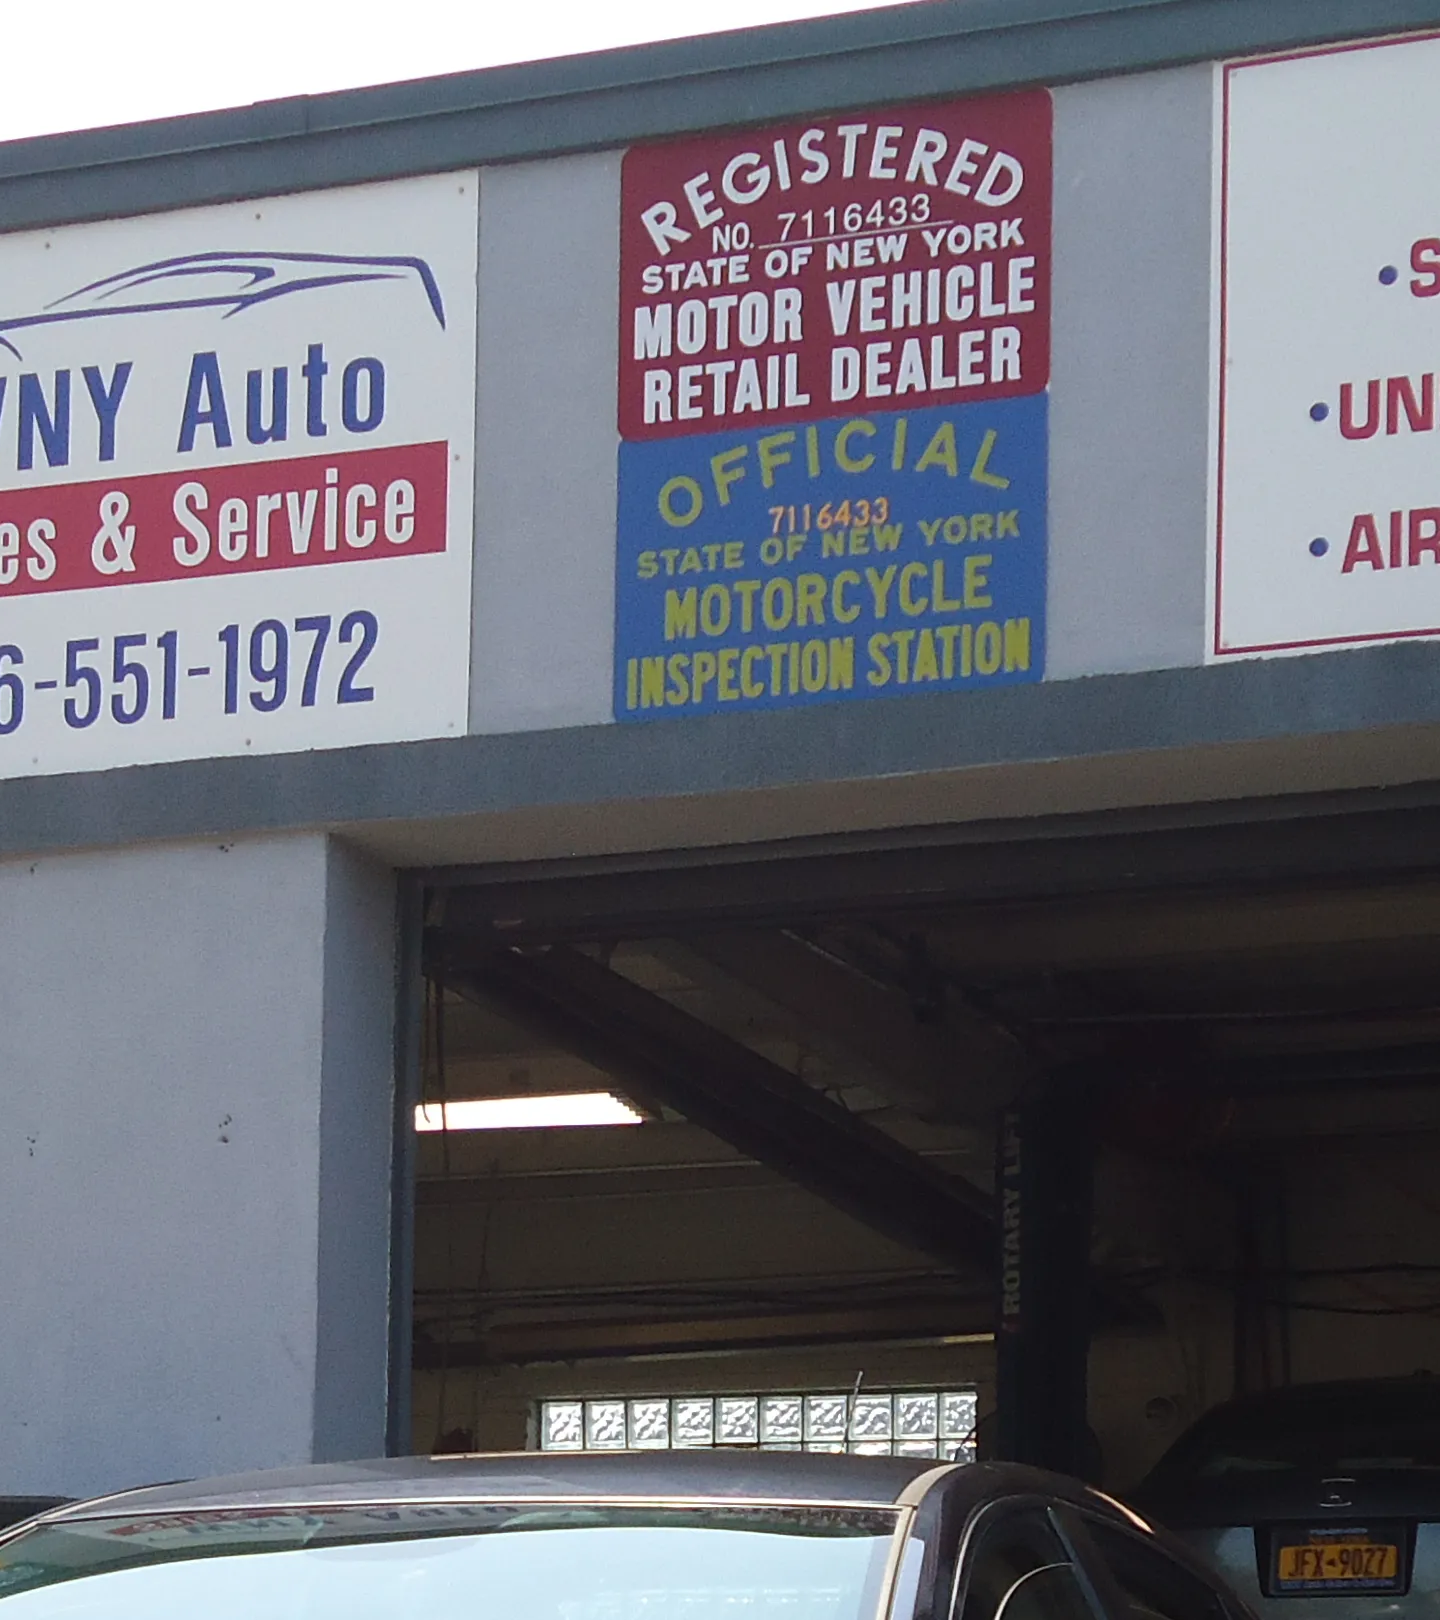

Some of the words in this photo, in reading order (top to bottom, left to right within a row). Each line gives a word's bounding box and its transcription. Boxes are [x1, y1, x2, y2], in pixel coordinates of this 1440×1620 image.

[640, 123, 1024, 256] REGISTERED
[777, 193, 931, 243] 7116433
[641, 254, 750, 295] STATE
[765, 246, 813, 278] OF
[826, 234, 908, 272] NEW
[921, 217, 1025, 258] YORK
[633, 287, 803, 361] MOTOR
[826, 255, 1036, 337] VEHICLE
[175, 343, 387, 453] Auto
[643, 353, 811, 425] RETAIL
[830, 326, 1022, 403] DEALER
[91, 490, 137, 576] &
[172, 467, 416, 568] Service
[658, 417, 1010, 527] OFFICIAL
[768, 496, 890, 534] 7116433
[636, 541, 744, 579] STATE
[759, 534, 807, 566] OF
[821, 524, 903, 559] NEW
[917, 509, 1020, 547] YORK
[663, 553, 993, 642] MOTORCYCLE
[625, 635, 855, 711] INSPECTION
[866, 617, 1031, 687] STATION
[1001, 1187, 1021, 1316] ROTARY
